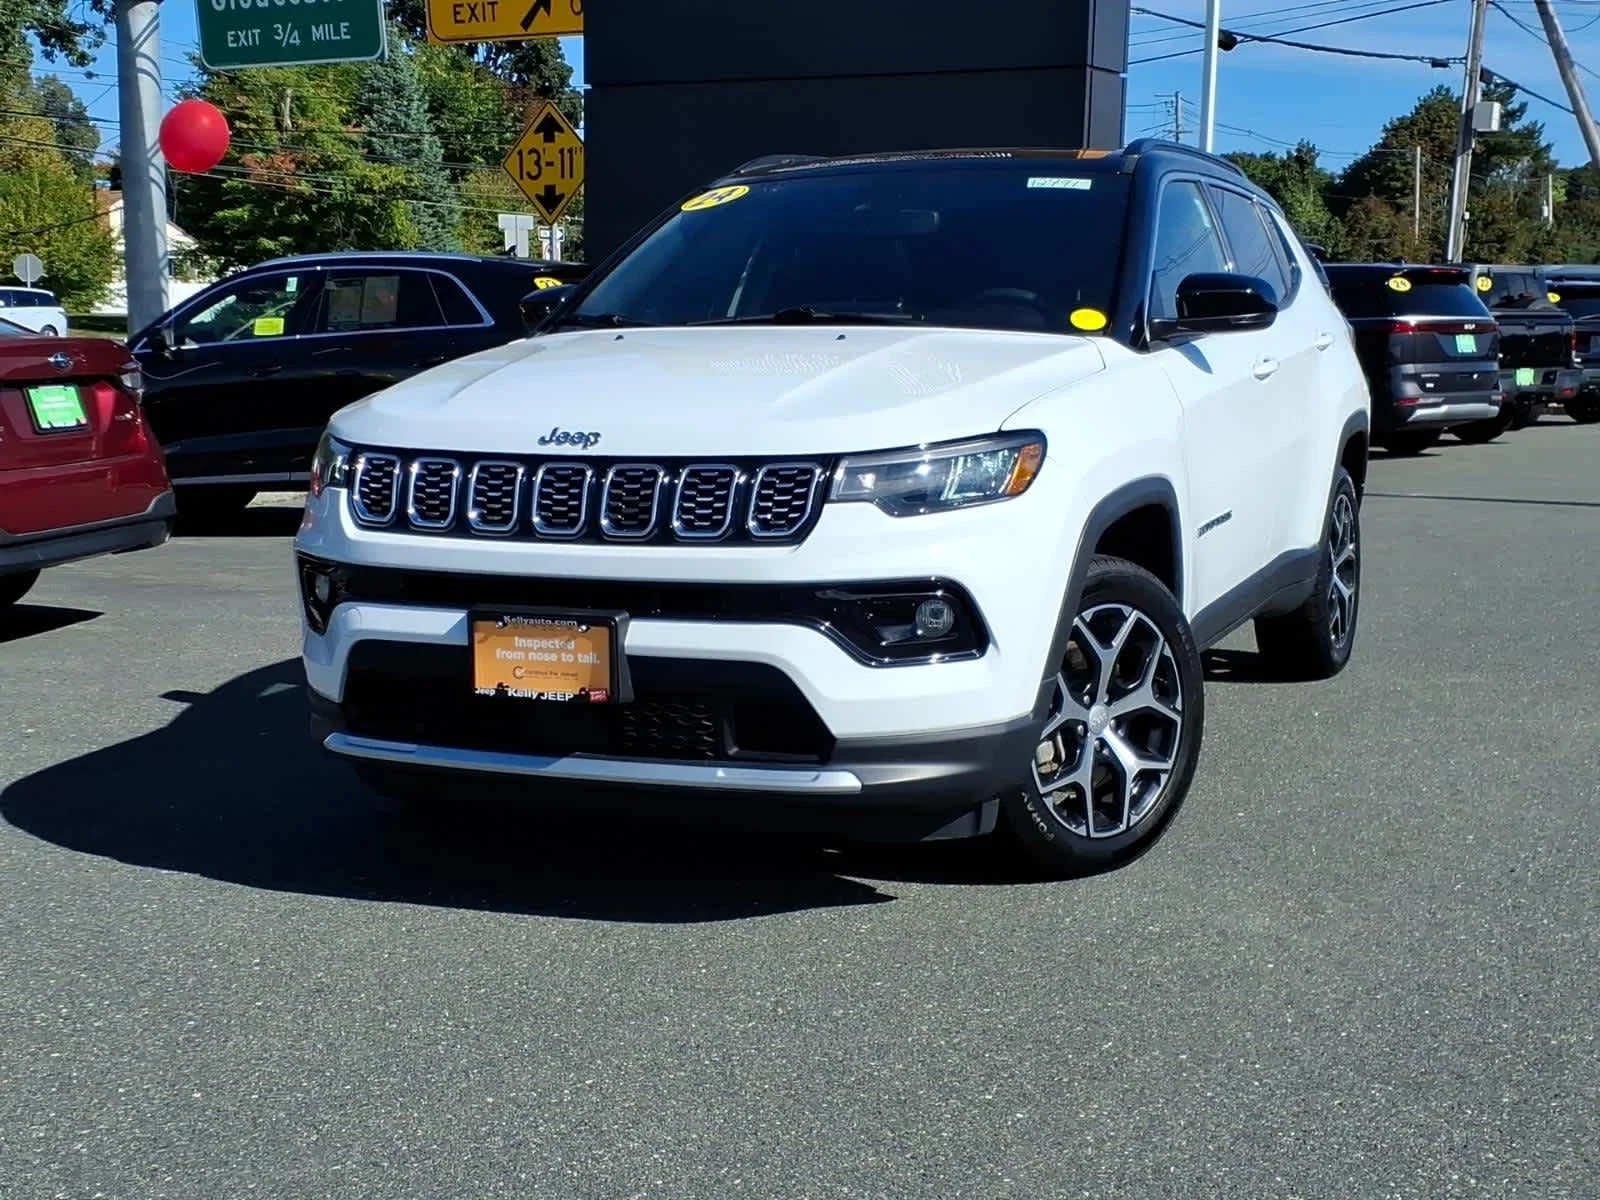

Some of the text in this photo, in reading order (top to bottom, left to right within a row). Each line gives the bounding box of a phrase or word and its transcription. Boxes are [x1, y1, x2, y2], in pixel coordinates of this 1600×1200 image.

[453, 1, 498, 24] EXIT
[227, 29, 261, 47] EXIT
[311, 22, 351, 41] MILE
[537, 427, 602, 449] Jeep
[514, 636, 576, 650] Inspected
[496, 648, 525, 660] from
[528, 651, 558, 662] nose
[561, 652, 575, 663] to
[504, 687, 538, 700] Kelly
[540, 690, 575, 702] JEEP
